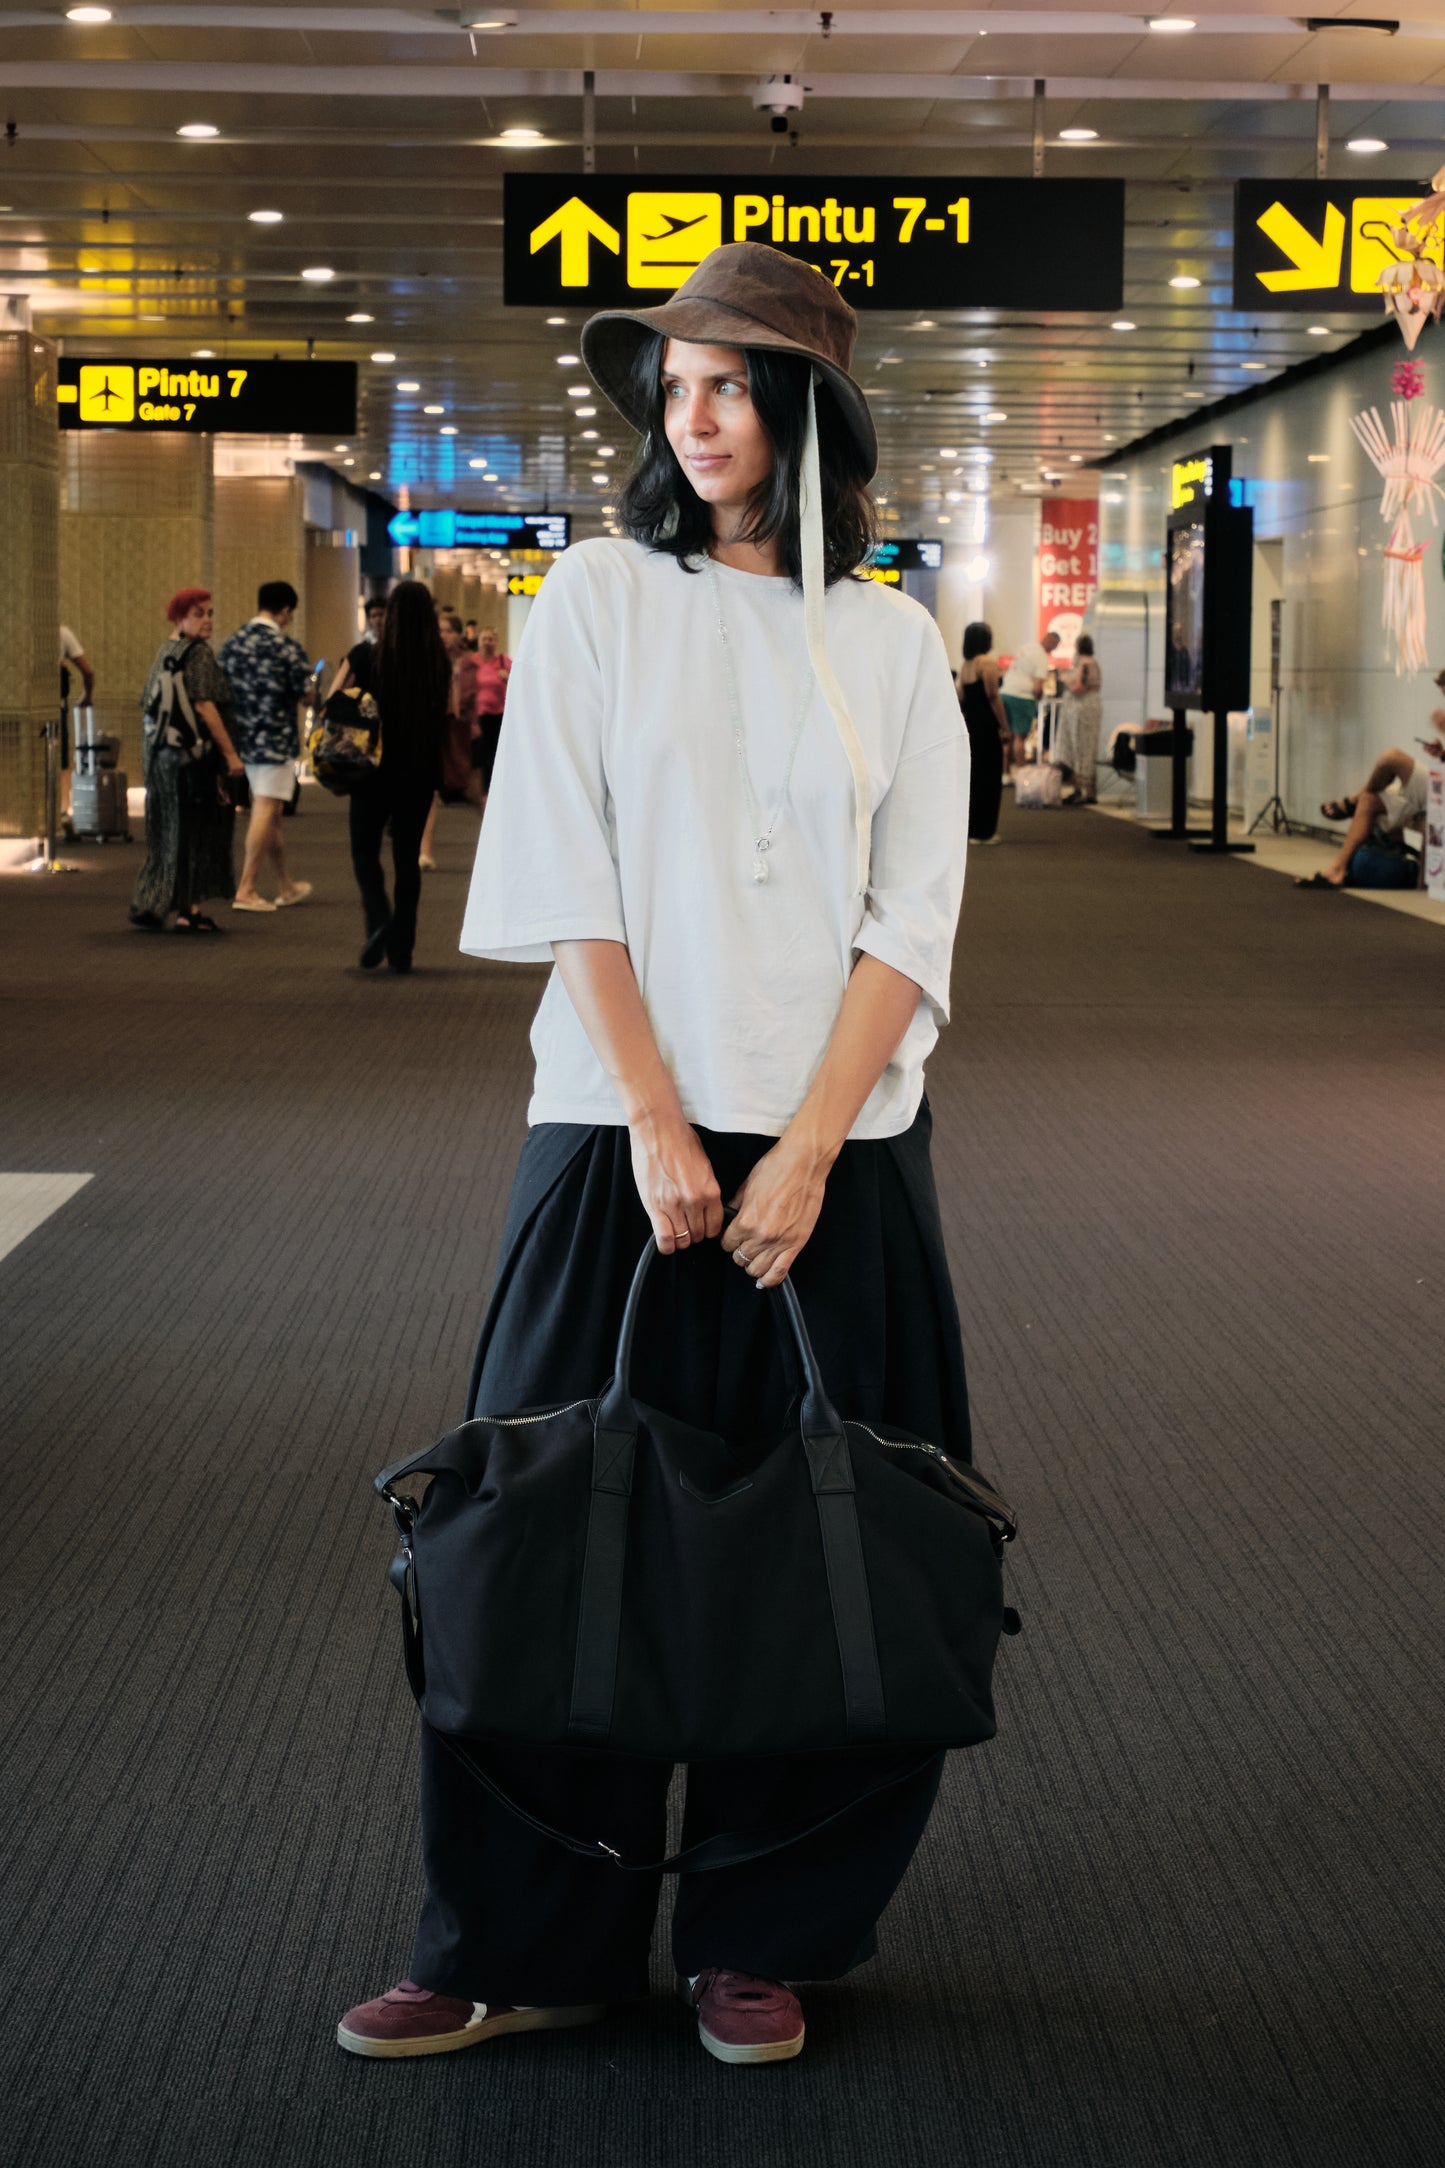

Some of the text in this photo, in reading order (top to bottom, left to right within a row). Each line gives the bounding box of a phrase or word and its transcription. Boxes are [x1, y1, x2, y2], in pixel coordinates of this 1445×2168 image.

[733, 194, 970, 244] Pintu 7-1
[829, 259, 874, 287] 7-1
[138, 366, 248, 398] Pintu 7
[138, 402, 197, 421] Gate 7
[1042, 523, 1083, 551] Buy
[1041, 553, 1081, 577] Get
